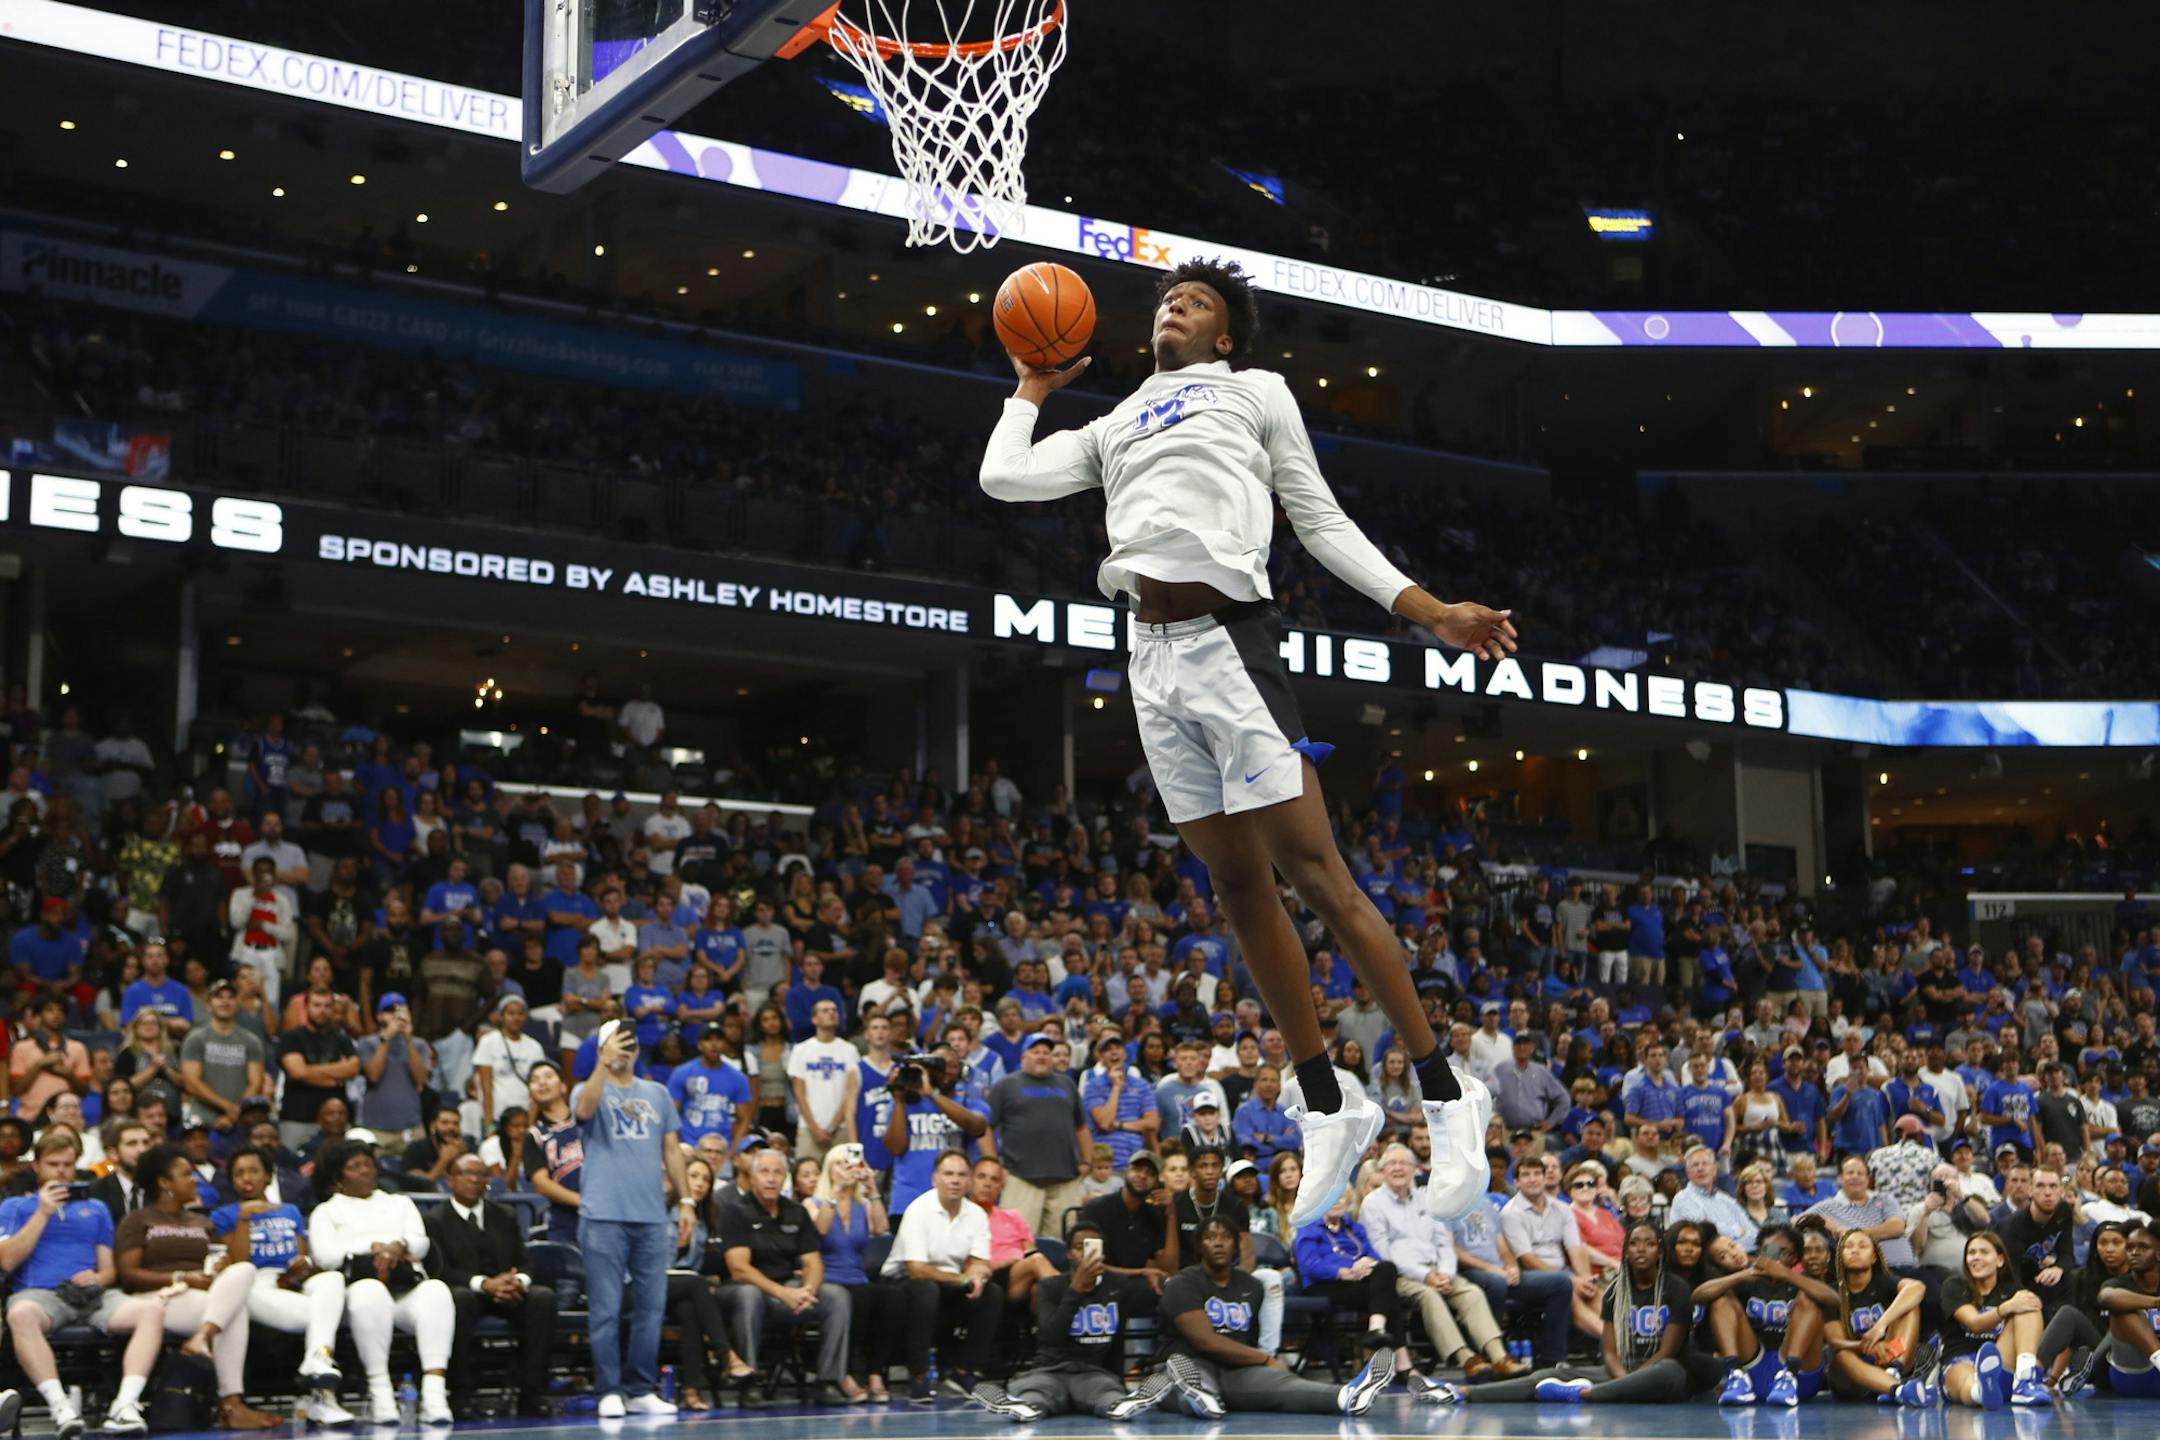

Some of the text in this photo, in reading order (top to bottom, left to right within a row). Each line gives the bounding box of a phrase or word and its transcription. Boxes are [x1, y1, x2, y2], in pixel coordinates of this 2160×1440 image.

[155, 28, 509, 132] FEDEX.COM/DELIVER
[1079, 216, 1172, 267] FedEx
[1273, 260, 1504, 330] FEDEX.COM/DELIVER
[318, 535, 968, 634] SPONSORED BY ASHLEY HOMESTORE
[993, 593, 1783, 729] MEHIS MADNESS
[1984, 903, 2007, 919] 112
[614, 1107, 648, 1136] M
[1204, 1296, 1252, 1332] 901
